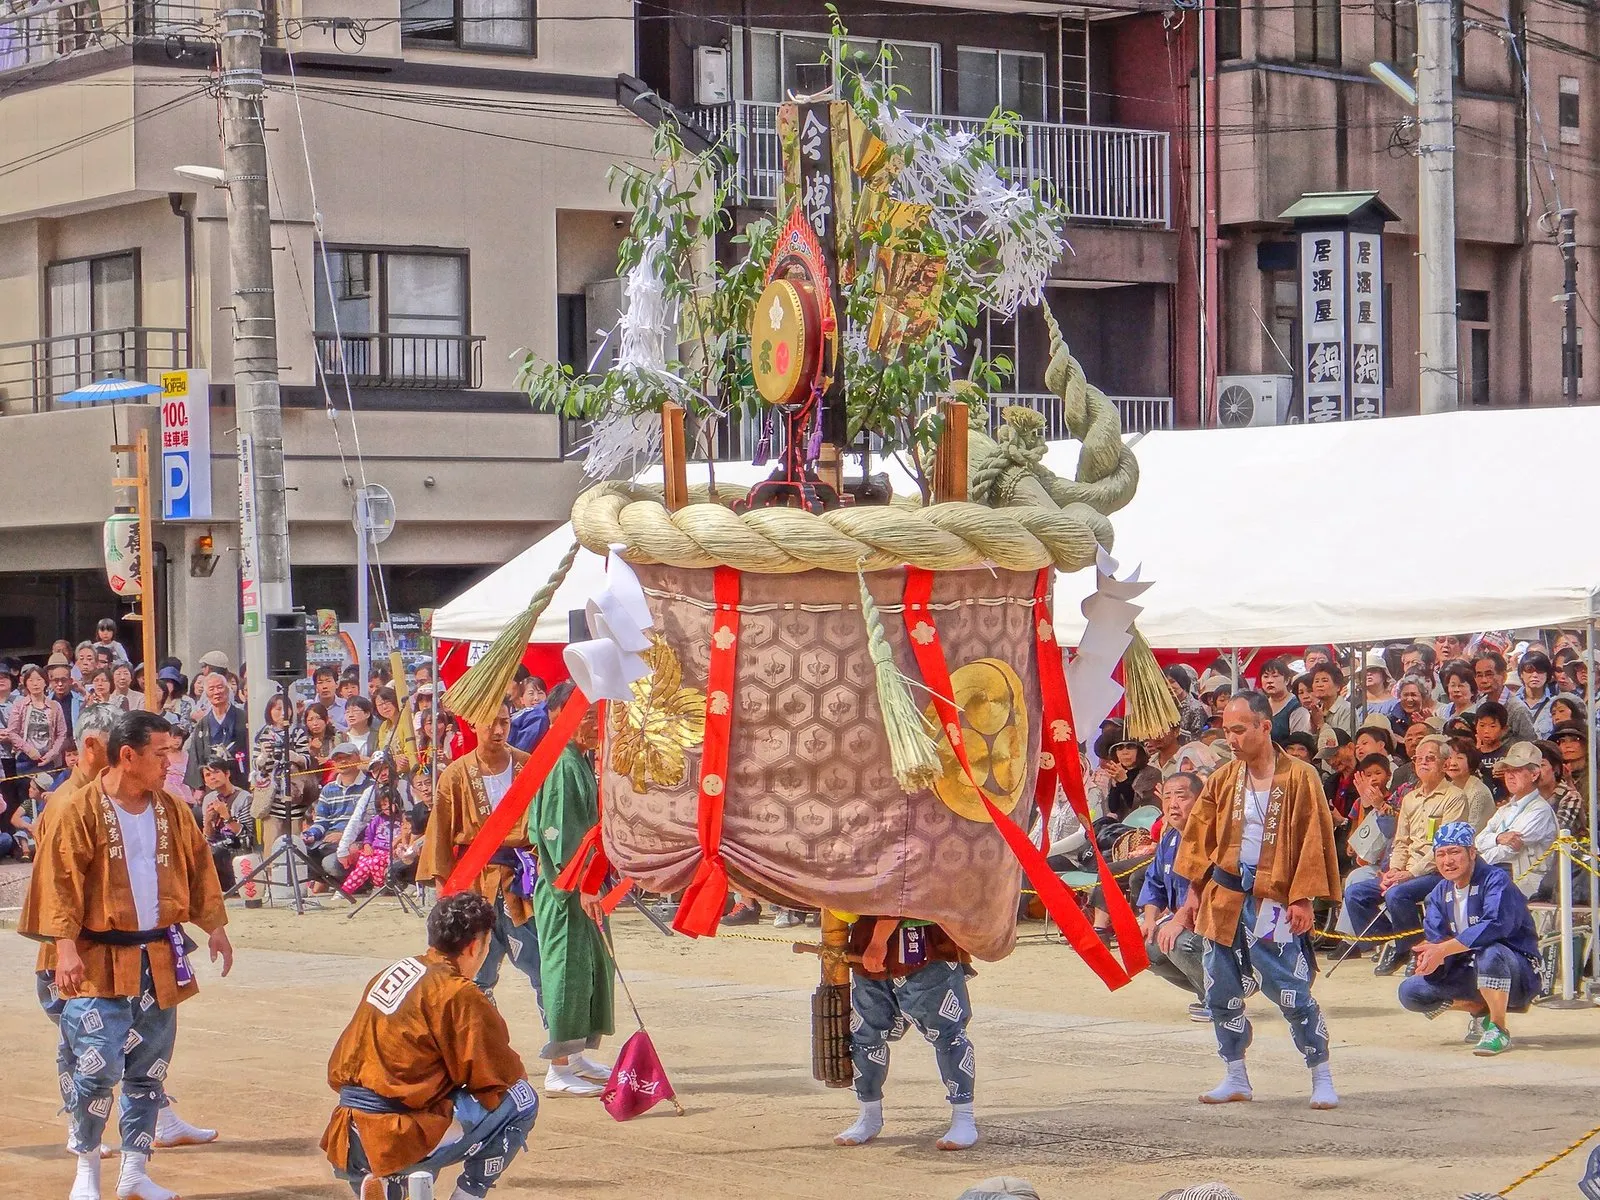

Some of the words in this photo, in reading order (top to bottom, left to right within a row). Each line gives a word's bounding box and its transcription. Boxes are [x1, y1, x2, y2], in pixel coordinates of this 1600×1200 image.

[1313, 239, 1338, 324] 居酒屋
[1356, 241, 1377, 324] 居酒屋
[163, 430, 189, 448] 駐車場
[164, 455, 189, 516] P
[100, 793, 123, 860] 今博多町
[154, 801, 170, 868] 今博多町
[1263, 786, 1284, 845] 今博多町
